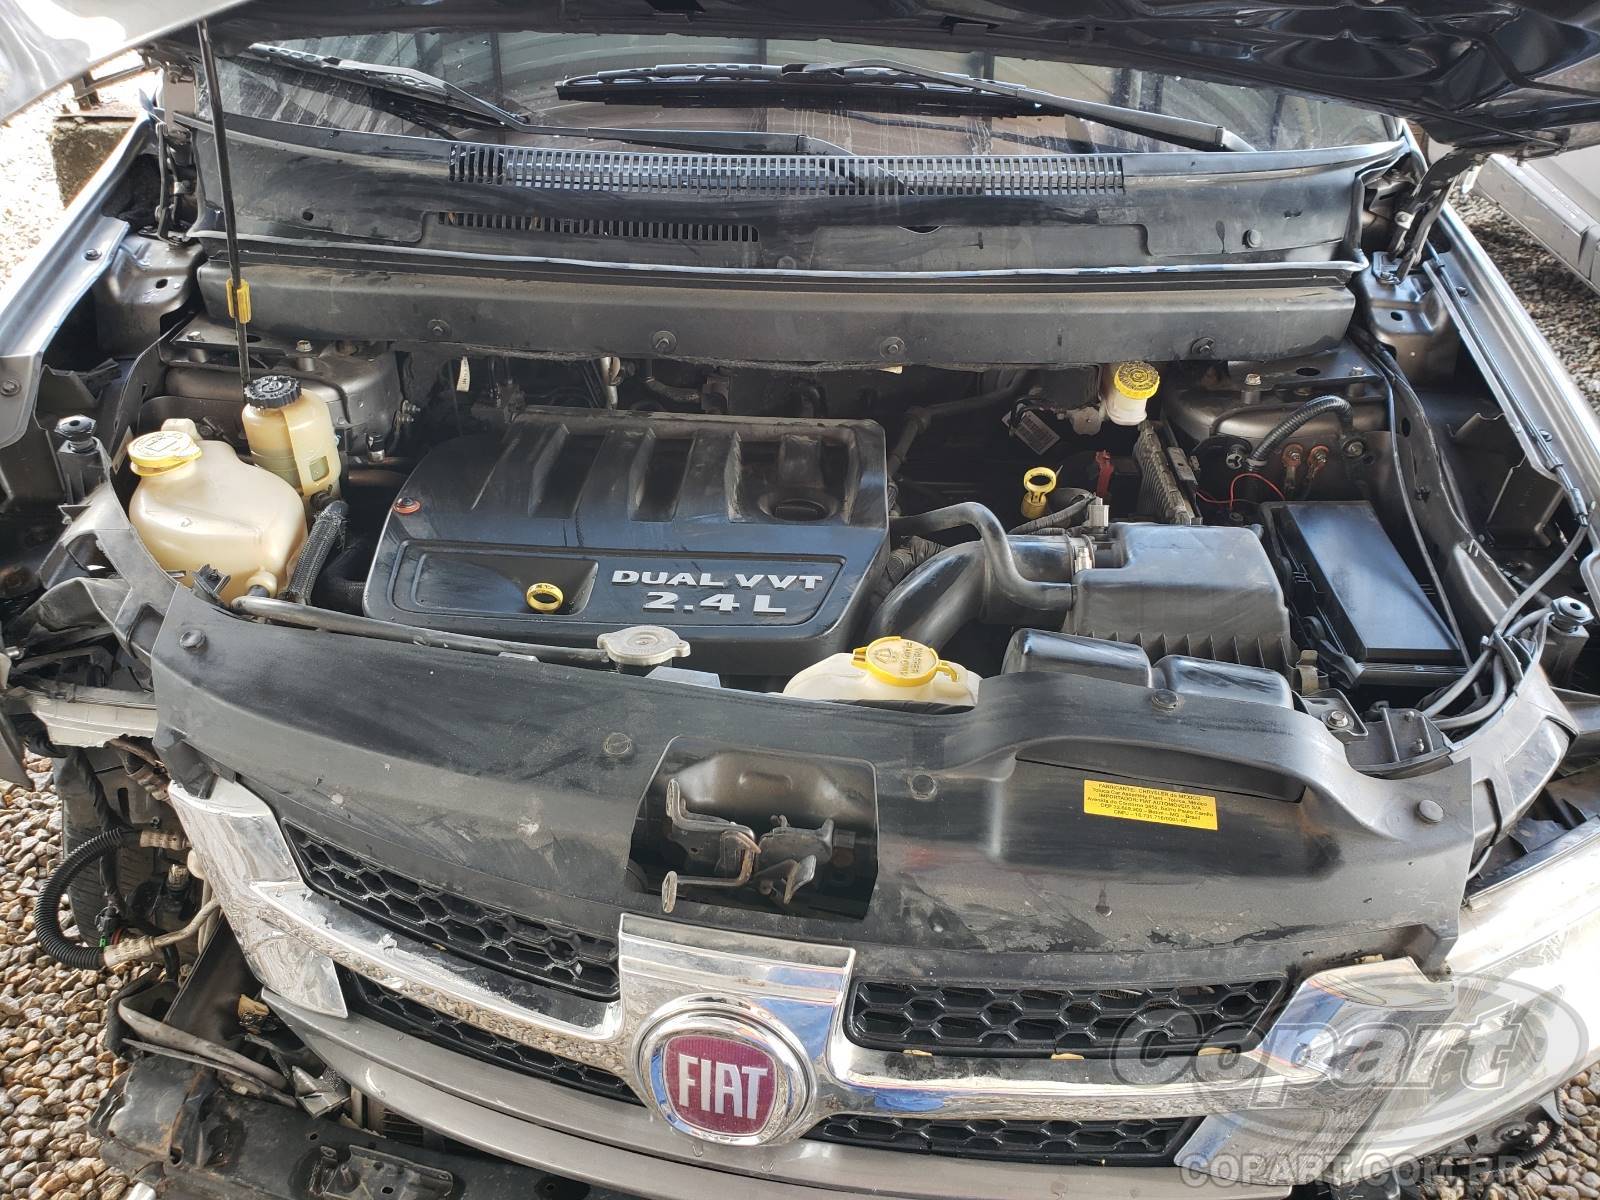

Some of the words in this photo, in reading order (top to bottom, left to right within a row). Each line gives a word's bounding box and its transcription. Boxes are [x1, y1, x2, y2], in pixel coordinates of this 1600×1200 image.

[611, 570, 727, 589] DUAL
[735, 573, 823, 590] VVT
[1098, 783, 1135, 792] FABRICANTE:
[1138, 788, 1168, 796] CHRYSLER
[1098, 792, 1138, 802] IMPORTADOR:
[678, 1053, 768, 1120] FIAT
